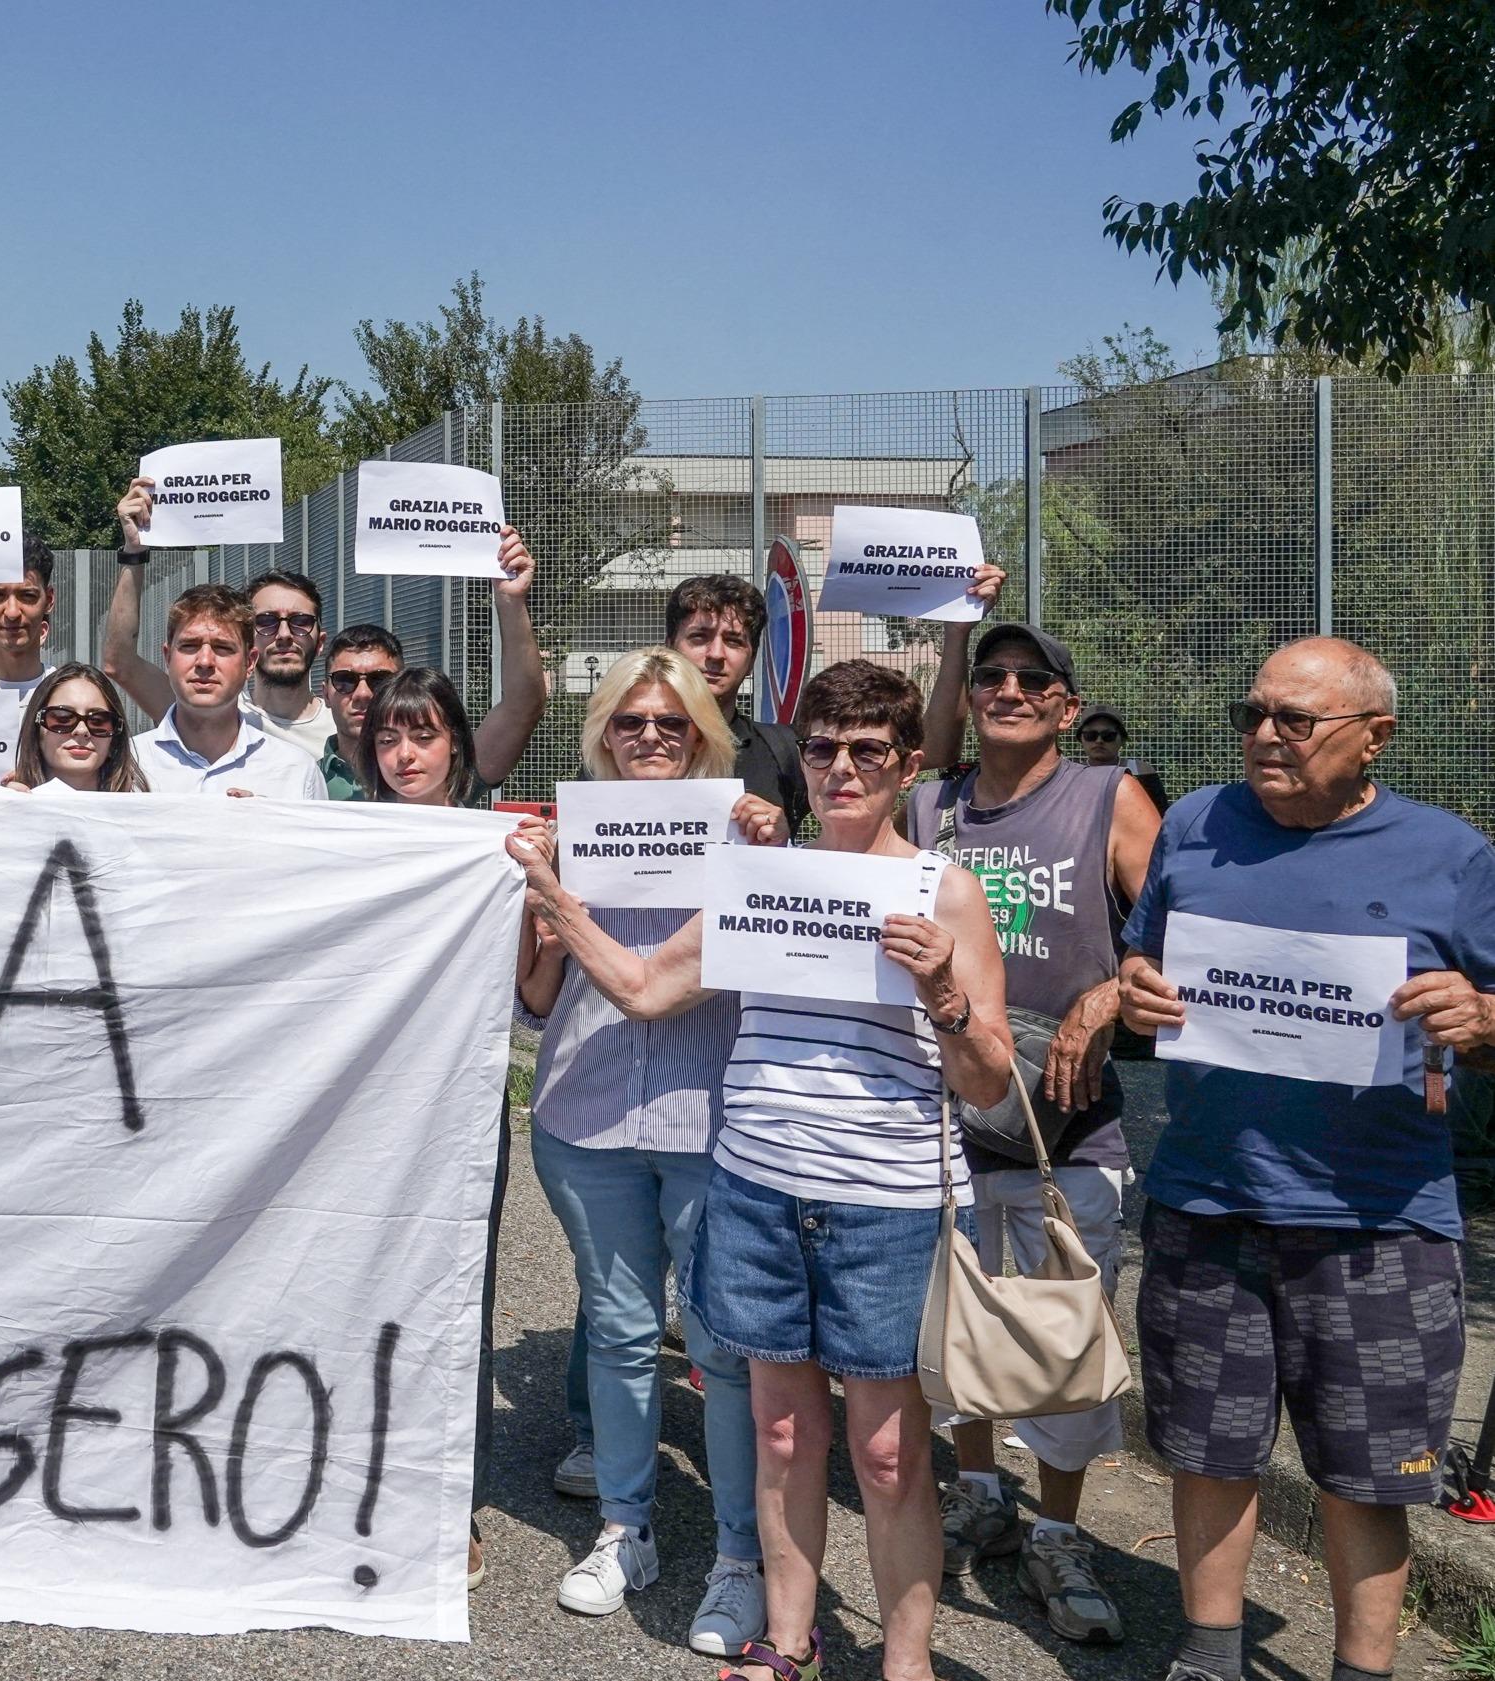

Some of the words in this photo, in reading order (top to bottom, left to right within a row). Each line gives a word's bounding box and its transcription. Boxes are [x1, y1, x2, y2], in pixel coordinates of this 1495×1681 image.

[163, 475, 219, 488] GRAZIA
[222, 473, 252, 486] PER
[197, 489, 270, 504] ROGGERO
[389, 499, 449, 514] GRAZIA
[452, 501, 483, 515] PER
[368, 516, 421, 531] MARIO
[424, 519, 501, 534] ROGGERO
[863, 544, 925, 559] GRAZIA
[927, 546, 958, 560] PER
[839, 562, 895, 576] MARIO
[896, 564, 976, 579] ROGGERO
[595, 822, 667, 837] GRAZIA
[670, 821, 708, 836] PER
[572, 843, 635, 857] MARIO
[638, 841, 730, 857] ROGGE
[979, 856, 1075, 916] ESSE
[746, 893, 826, 915] GRAZIA
[828, 899, 871, 918] PER
[990, 908, 1010, 924] 59
[719, 914, 789, 935] MARIO
[792, 920, 882, 943] ROGGER
[1206, 967, 1297, 995] GRAZIA
[1301, 980, 1353, 1002] PER
[1178, 985, 1255, 1012] MARIO
[1259, 997, 1384, 1028] ROGGERO
